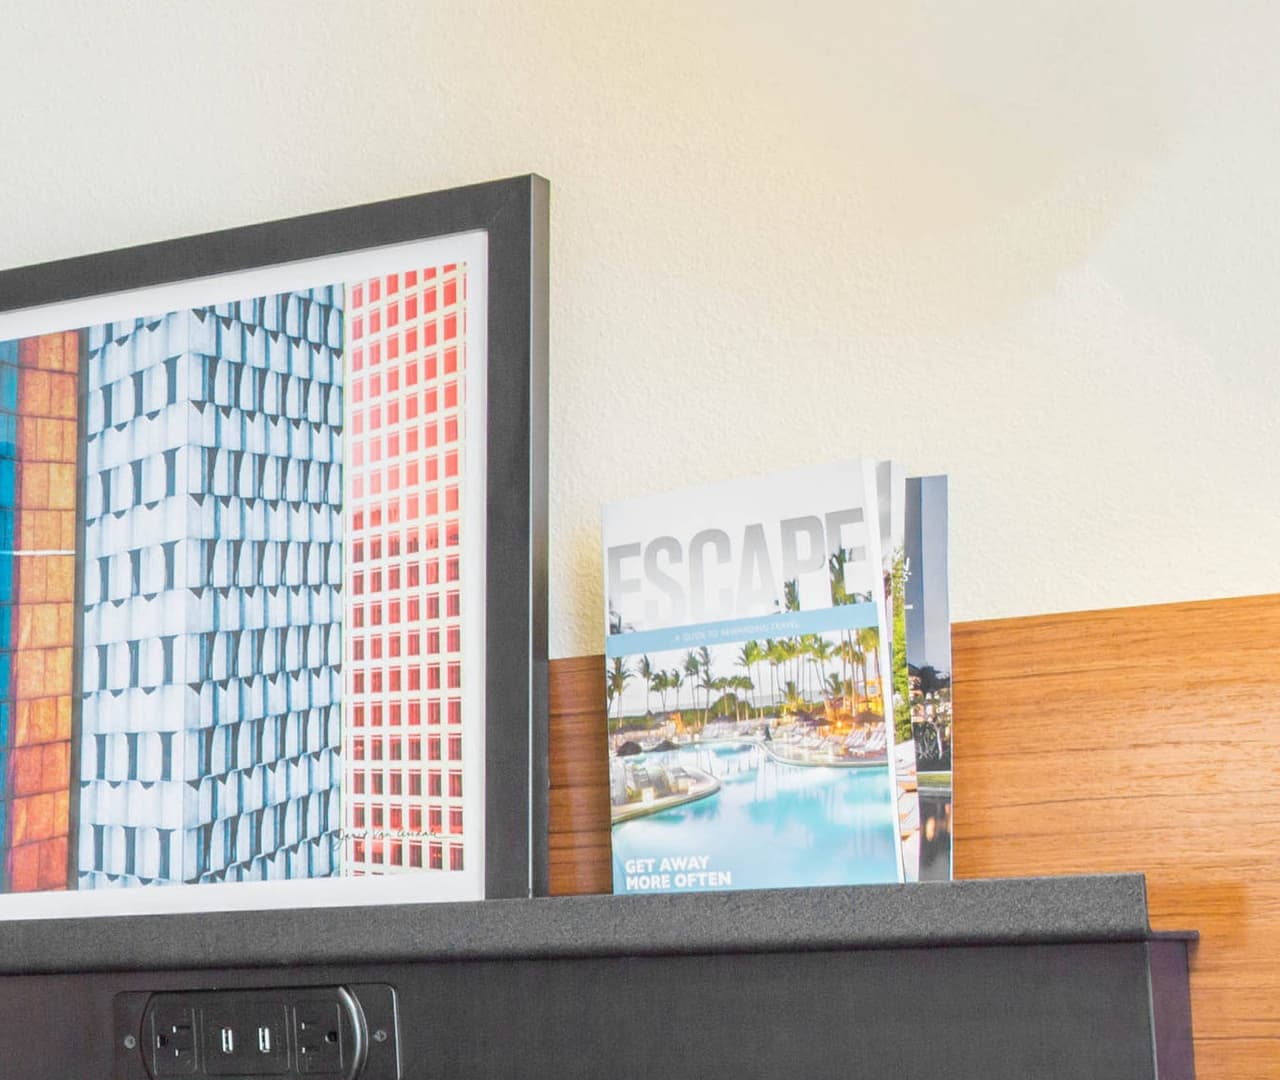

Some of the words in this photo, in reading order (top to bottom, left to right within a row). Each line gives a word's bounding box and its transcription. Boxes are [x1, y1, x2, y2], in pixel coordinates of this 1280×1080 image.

[607, 507, 872, 635] ESCAPE
[625, 858, 656, 874] GET
[659, 855, 711, 872] AWAY
[626, 874, 671, 890] MORE
[674, 871, 732, 888] OFTEN
